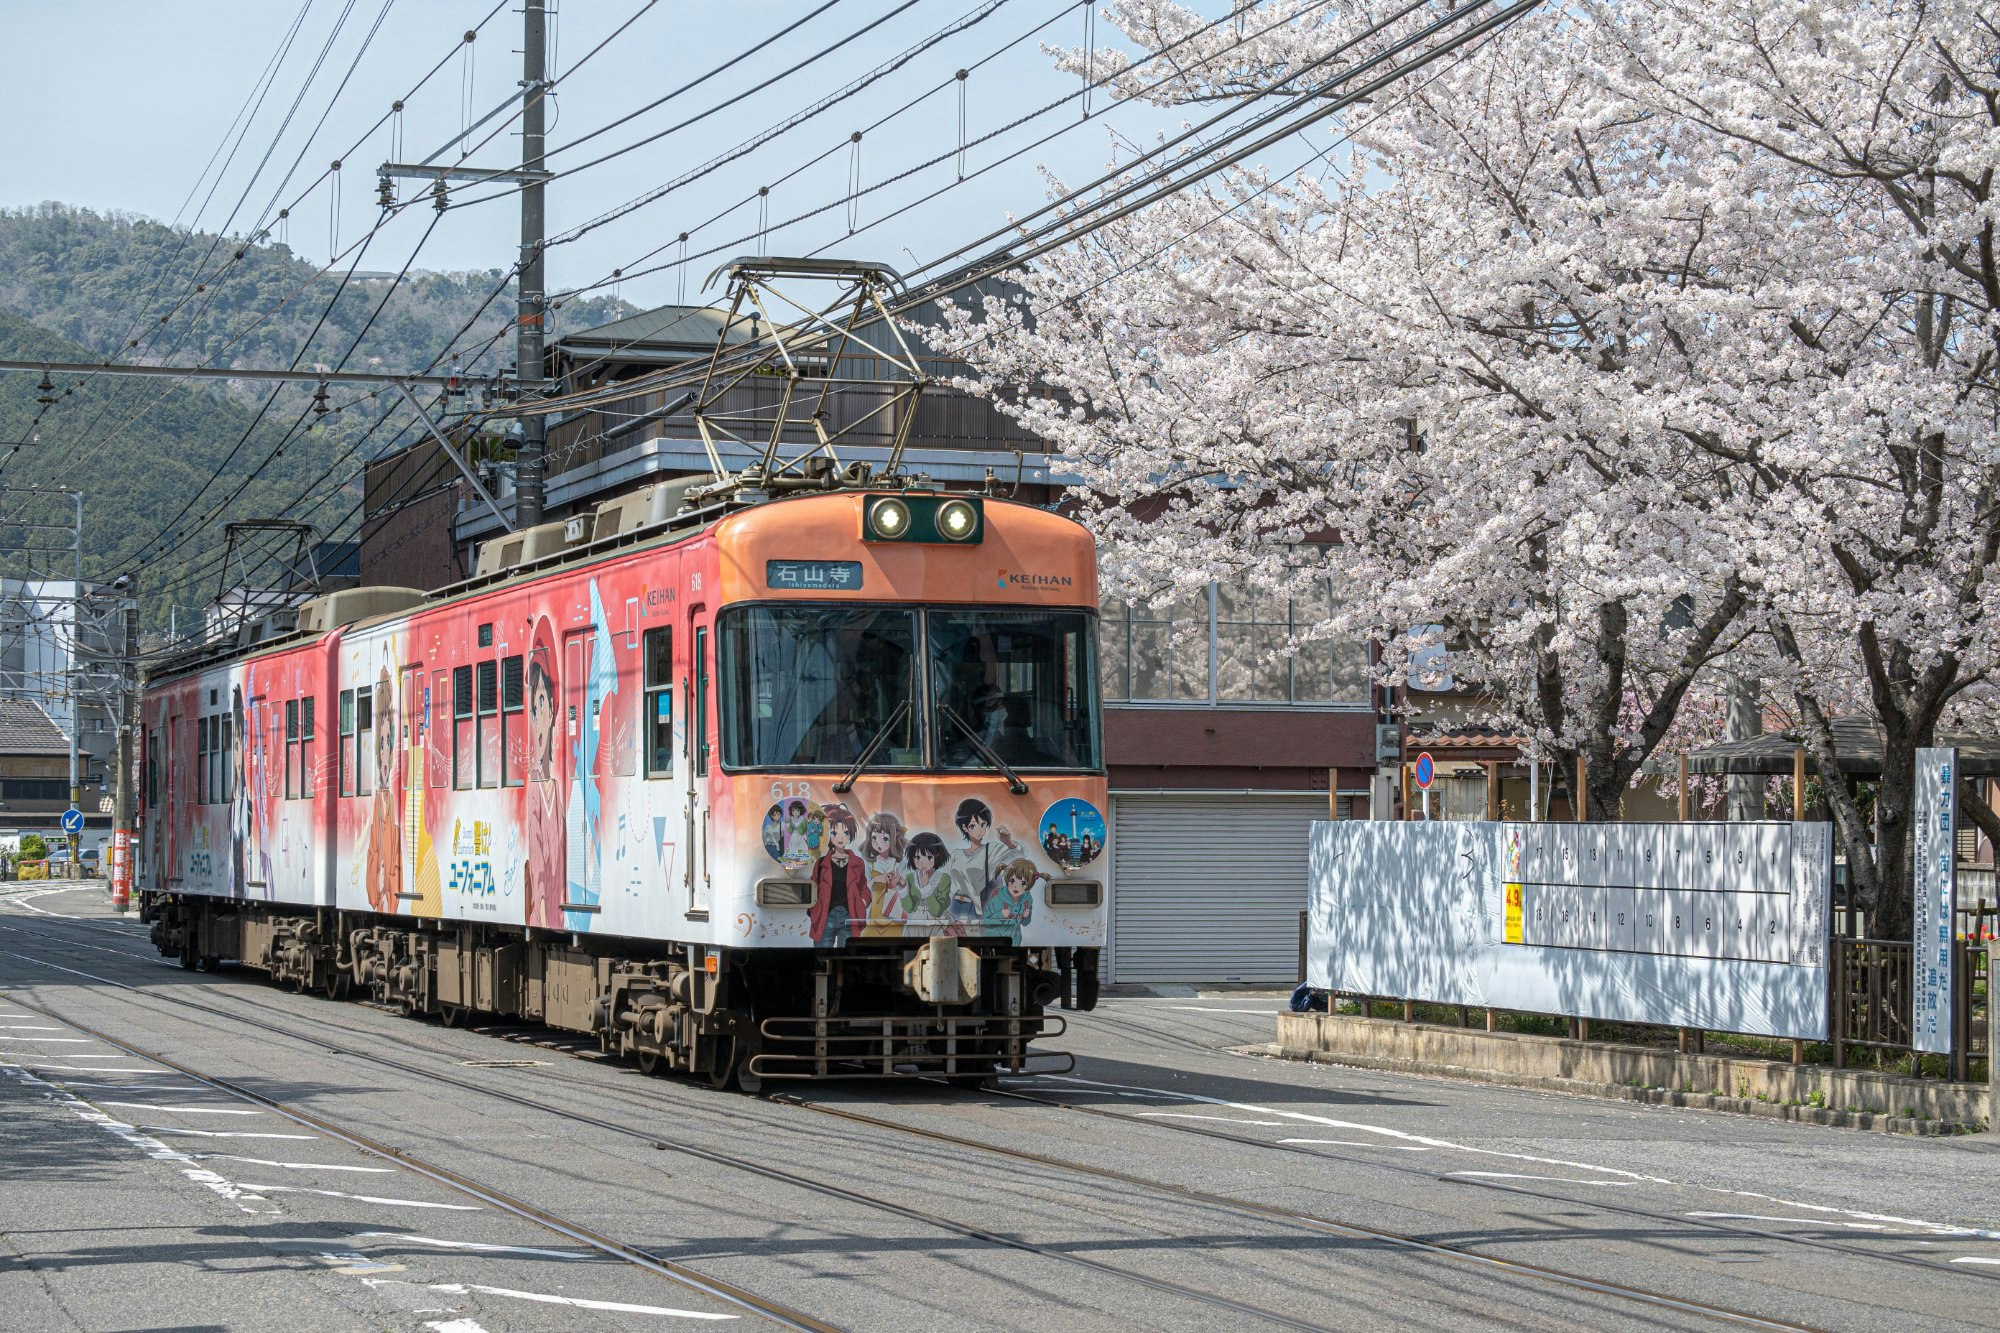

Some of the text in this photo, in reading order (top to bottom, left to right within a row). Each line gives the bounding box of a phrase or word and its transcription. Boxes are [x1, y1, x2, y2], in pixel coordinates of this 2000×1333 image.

[777, 565, 850, 583] 石山寺
[1009, 574, 1072, 586] KEIHAN
[691, 572, 702, 591] 618
[646, 587, 675, 606] KEIHAN
[771, 781, 811, 799] 618
[1536, 847, 1543, 859] 17
[1562, 847, 1569, 860] 15
[1589, 849, 1597, 861] 13
[1617, 849, 1623, 861] 11
[1646, 849, 1651, 862] 9
[1676, 850, 1681, 863] 7
[1706, 850, 1711, 864] 5
[1737, 850, 1743, 864] 3
[1771, 852, 1775, 865] 1
[449, 860, 496, 897] ユーフォニアム
[1536, 908, 1542, 921] 18
[1562, 910, 1569, 922] 16
[1590, 912, 1596, 924] 14
[1617, 913, 1625, 925] 12
[1645, 914, 1653, 927] 10
[1675, 916, 1681, 929] 8
[1705, 918, 1711, 930] 6
[1737, 919, 1743, 932] 4
[1770, 921, 1776, 934] 2
[1927, 967, 1937, 1034] 追放だ
